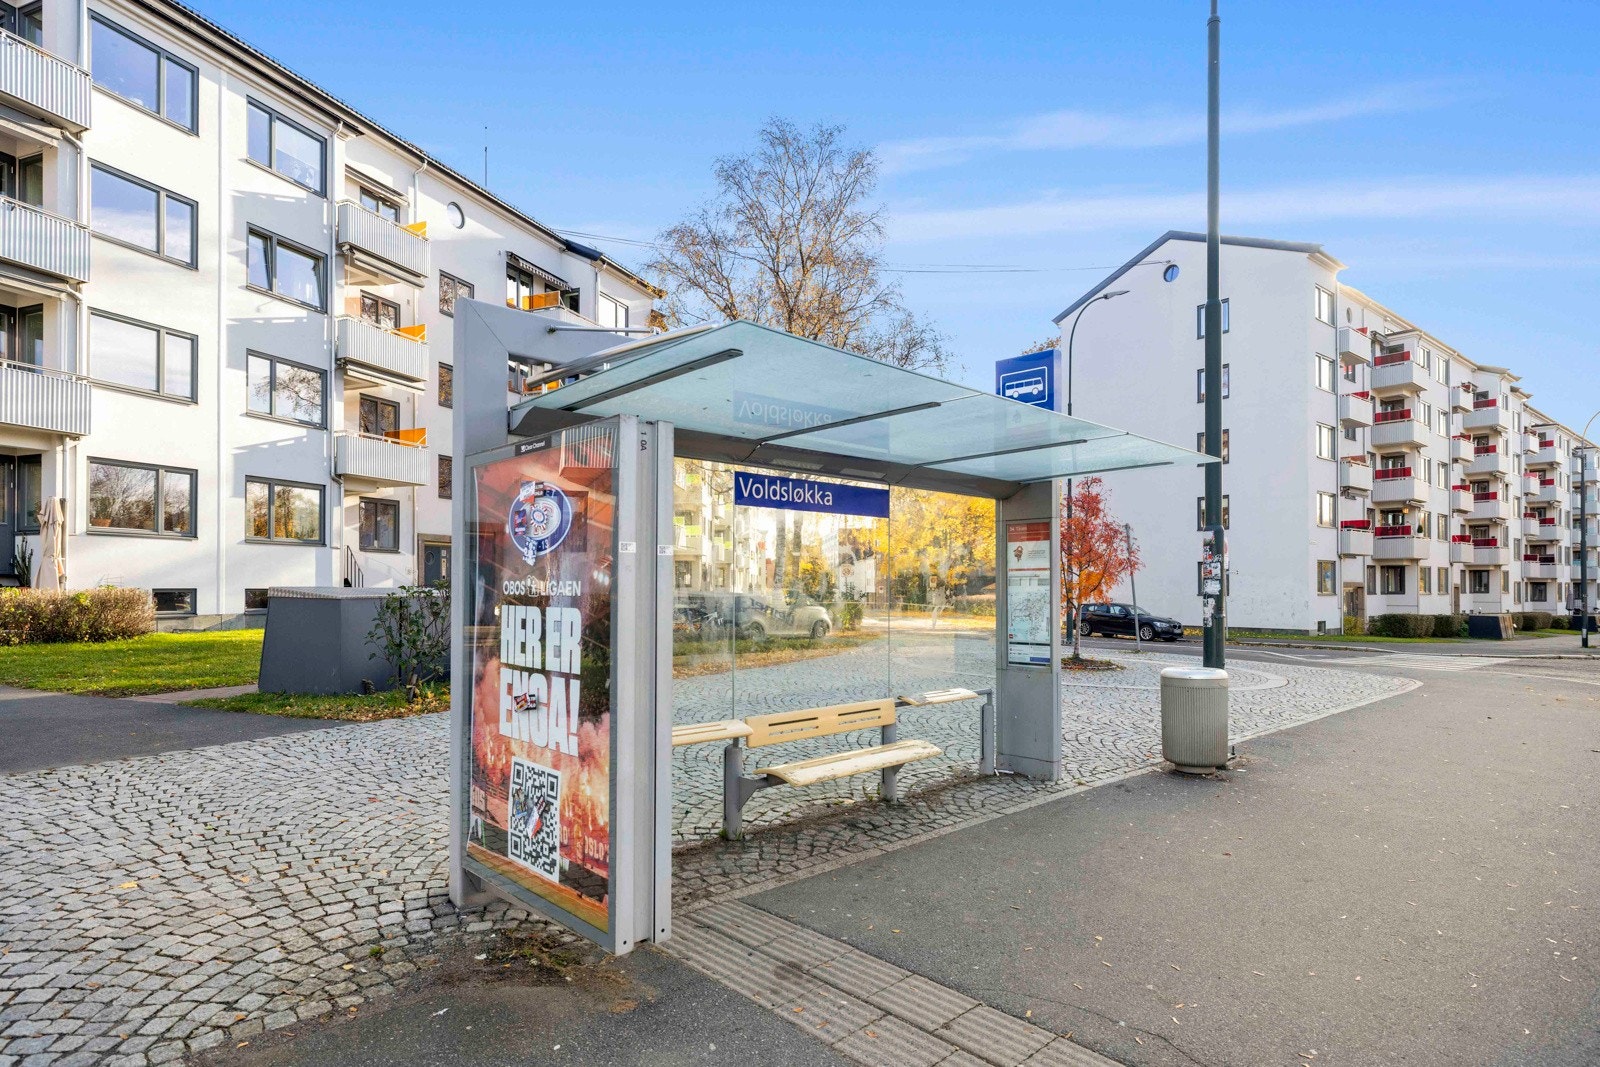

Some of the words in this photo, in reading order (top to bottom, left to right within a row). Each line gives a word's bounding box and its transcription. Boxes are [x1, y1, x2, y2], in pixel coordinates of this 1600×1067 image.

[739, 477, 832, 505] Voldsløkka
[503, 581, 525, 595] OBOS
[541, 581, 581, 596] LIGAEN
[501, 605, 542, 669] HER
[545, 607, 581, 674] ER
[499, 668, 580, 757] ENGA!
